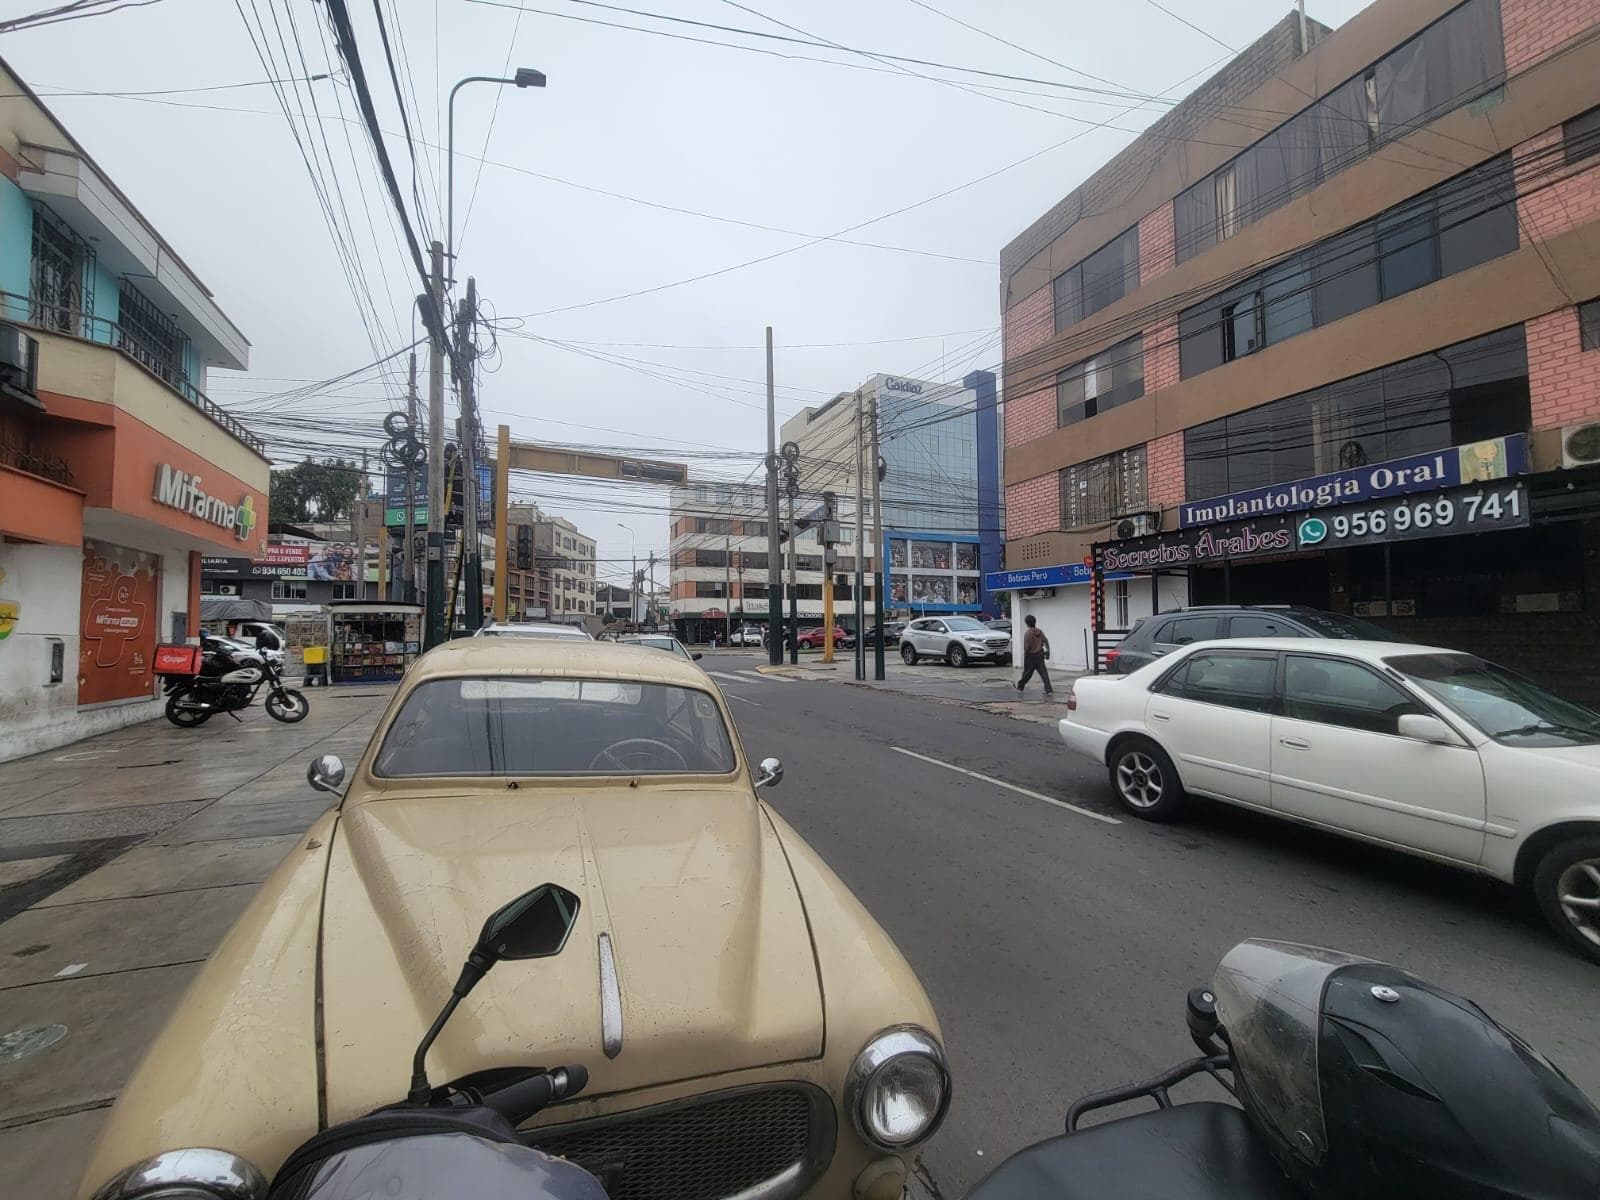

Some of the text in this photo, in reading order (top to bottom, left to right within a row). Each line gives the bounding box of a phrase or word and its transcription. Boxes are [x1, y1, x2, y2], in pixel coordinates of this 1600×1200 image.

[157, 463, 236, 529] Mifarma
[1186, 456, 1445, 524] Implantología Oral
[1333, 489, 1520, 538] 956 969 741
[261, 567, 306, 576] 934 650 402
[1103, 542, 1190, 570] Secretos
[1007, 573, 1031, 583] Boticas
